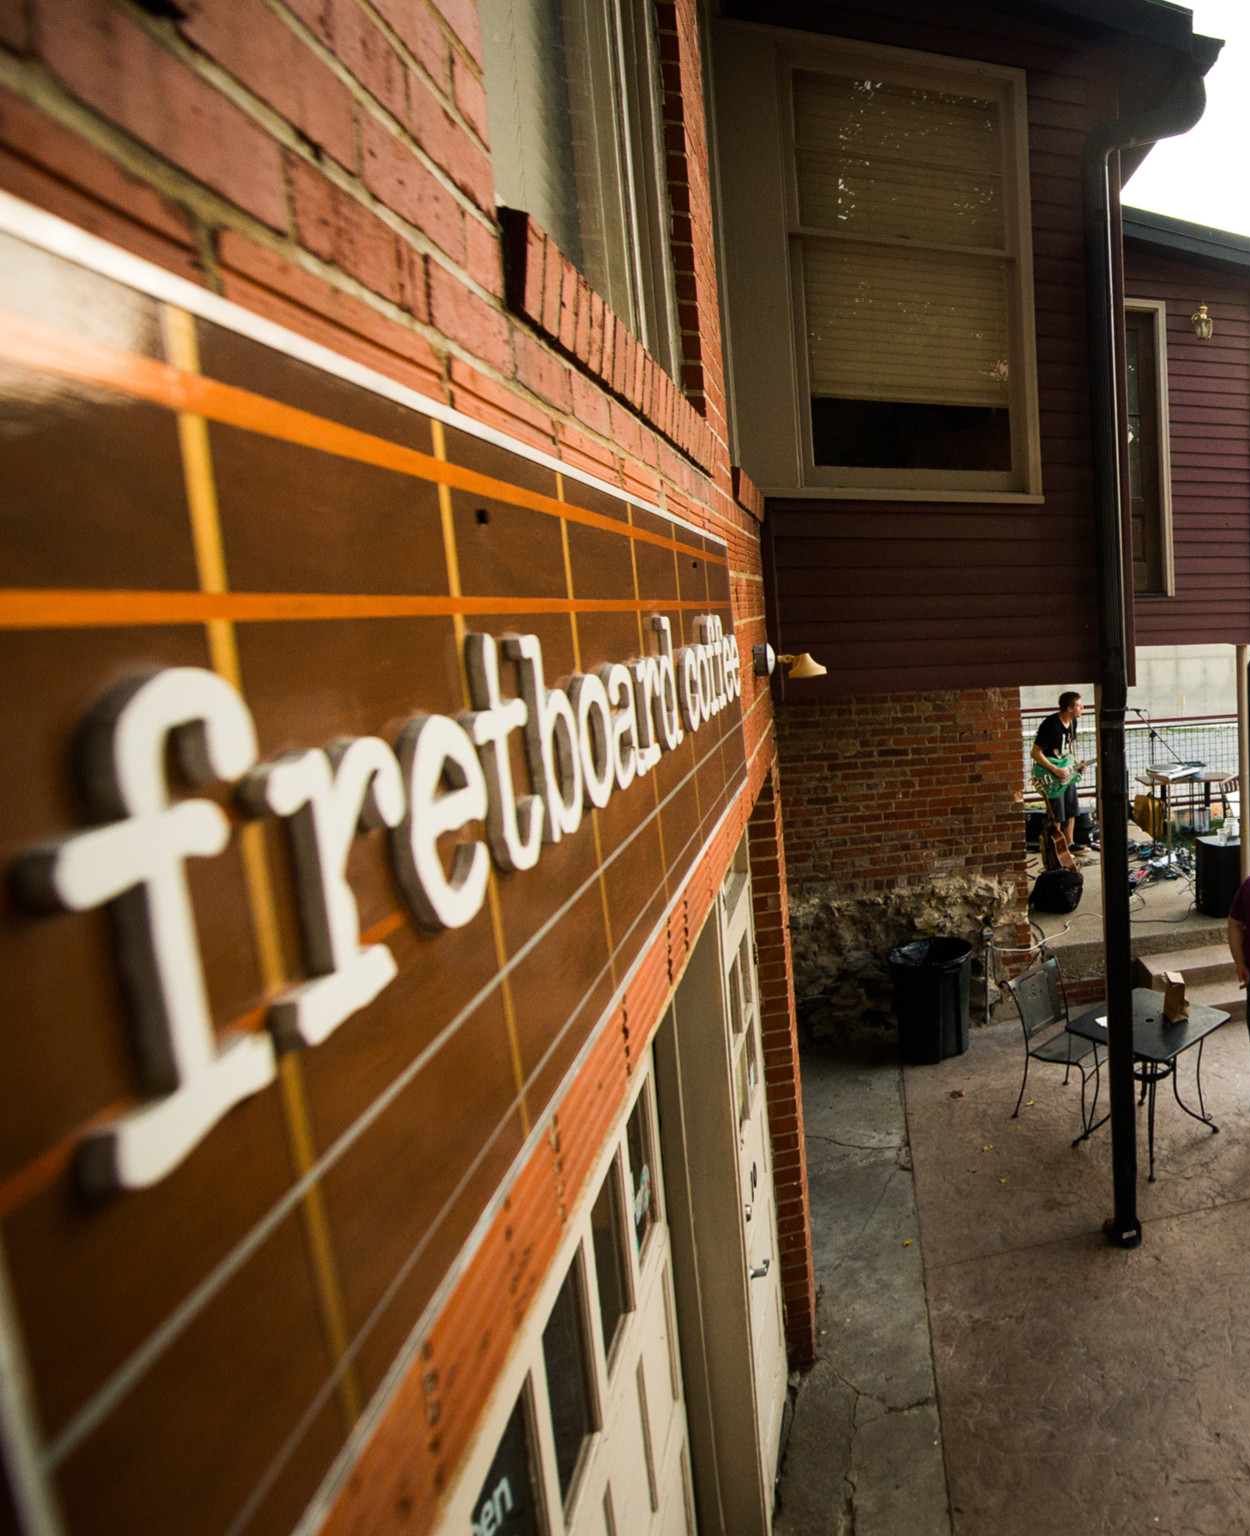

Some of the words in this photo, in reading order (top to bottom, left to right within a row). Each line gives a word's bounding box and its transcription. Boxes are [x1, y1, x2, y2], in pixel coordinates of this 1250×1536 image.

[50, 616, 682, 1190] fretboard
[680, 614, 741, 732] coffee
[472, 1475, 513, 1536] en
